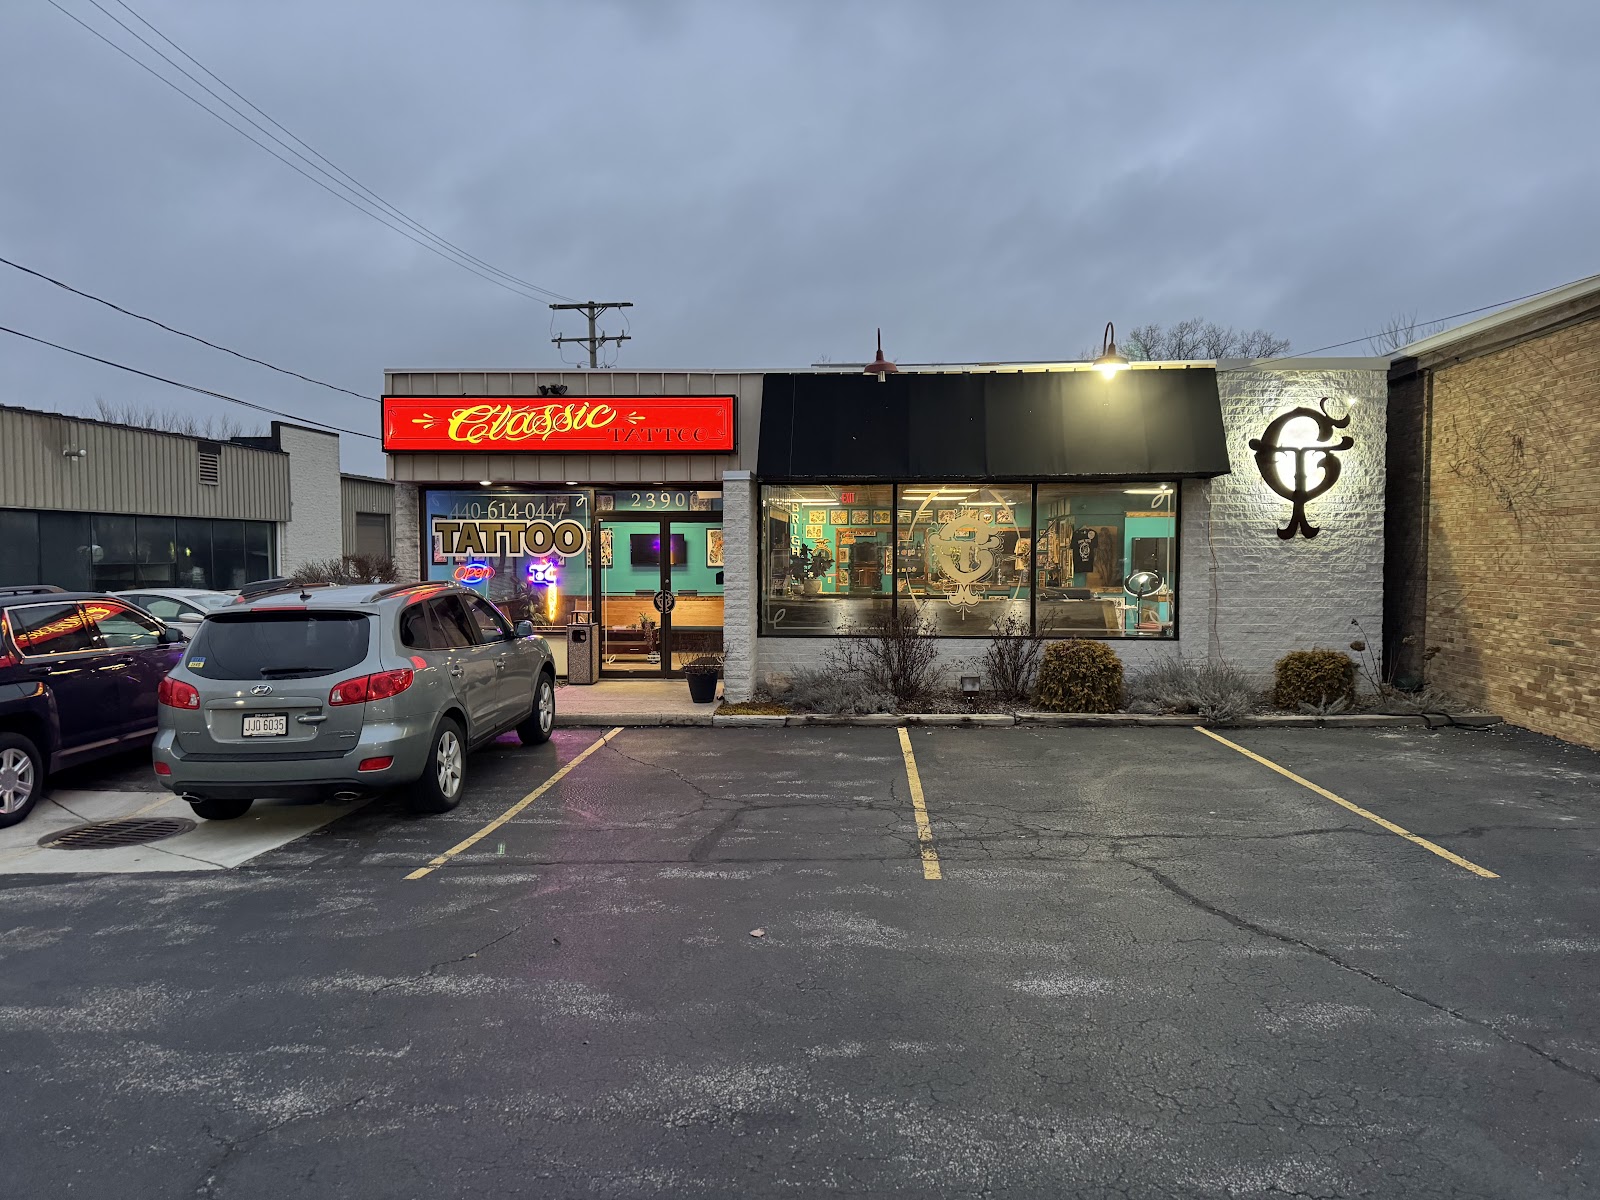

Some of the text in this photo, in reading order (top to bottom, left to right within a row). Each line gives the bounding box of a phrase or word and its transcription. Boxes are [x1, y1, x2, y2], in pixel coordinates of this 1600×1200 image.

[448, 402, 617, 444] Classic
[607, 427, 708, 443] TATTOO
[631, 492, 685, 509] 2390
[841, 492, 855, 504] EXIT
[449, 499, 567, 520] 440-614-0447
[432, 519, 587, 558] TATTOO
[454, 565, 495, 581] Open
[263, 718, 284, 731] 6035
